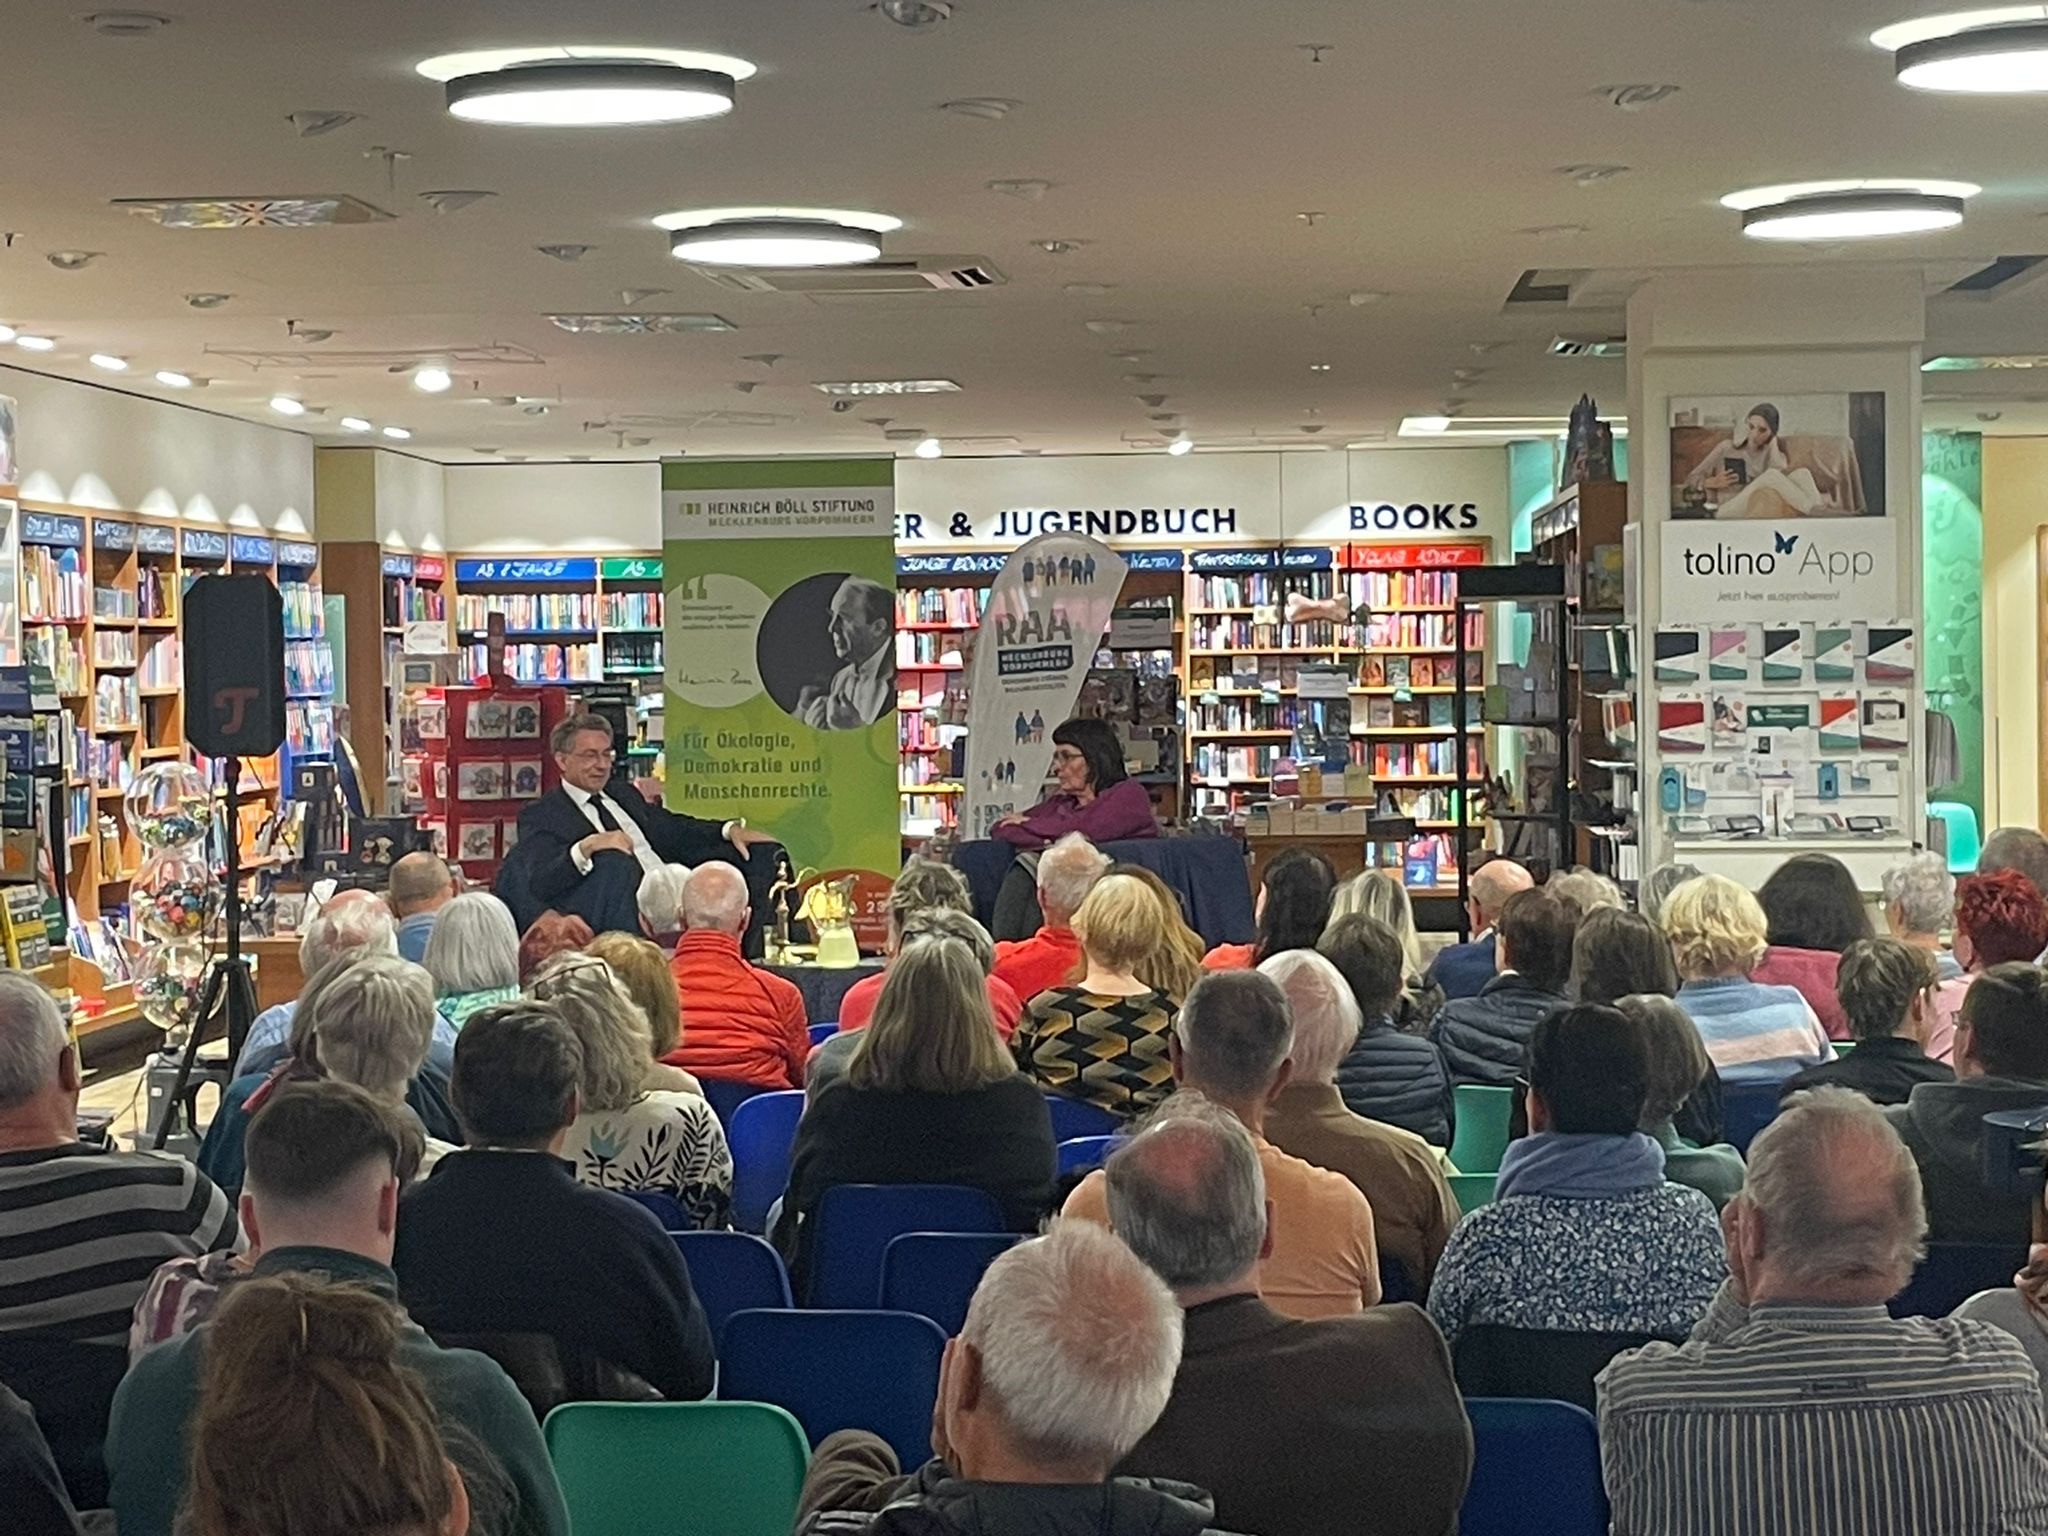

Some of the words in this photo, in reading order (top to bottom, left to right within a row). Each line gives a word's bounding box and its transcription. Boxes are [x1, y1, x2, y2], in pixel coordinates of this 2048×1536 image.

[708, 502, 771, 515] HEINRICH
[775, 498, 807, 513] BÖLL
[812, 499, 875, 512] STIFTUNG
[1350, 503, 1478, 530] BOOKS
[949, 512, 975, 538] &
[993, 508, 1236, 537] JUGENDBUCH
[1683, 542, 1776, 576] tolino
[1798, 542, 1874, 583] App
[995, 608, 1073, 646] RAA
[682, 731, 709, 749] Für
[683, 756, 783, 774] Demokratie
[790, 756, 822, 773] und
[684, 783, 833, 800] Menschenrechte.
